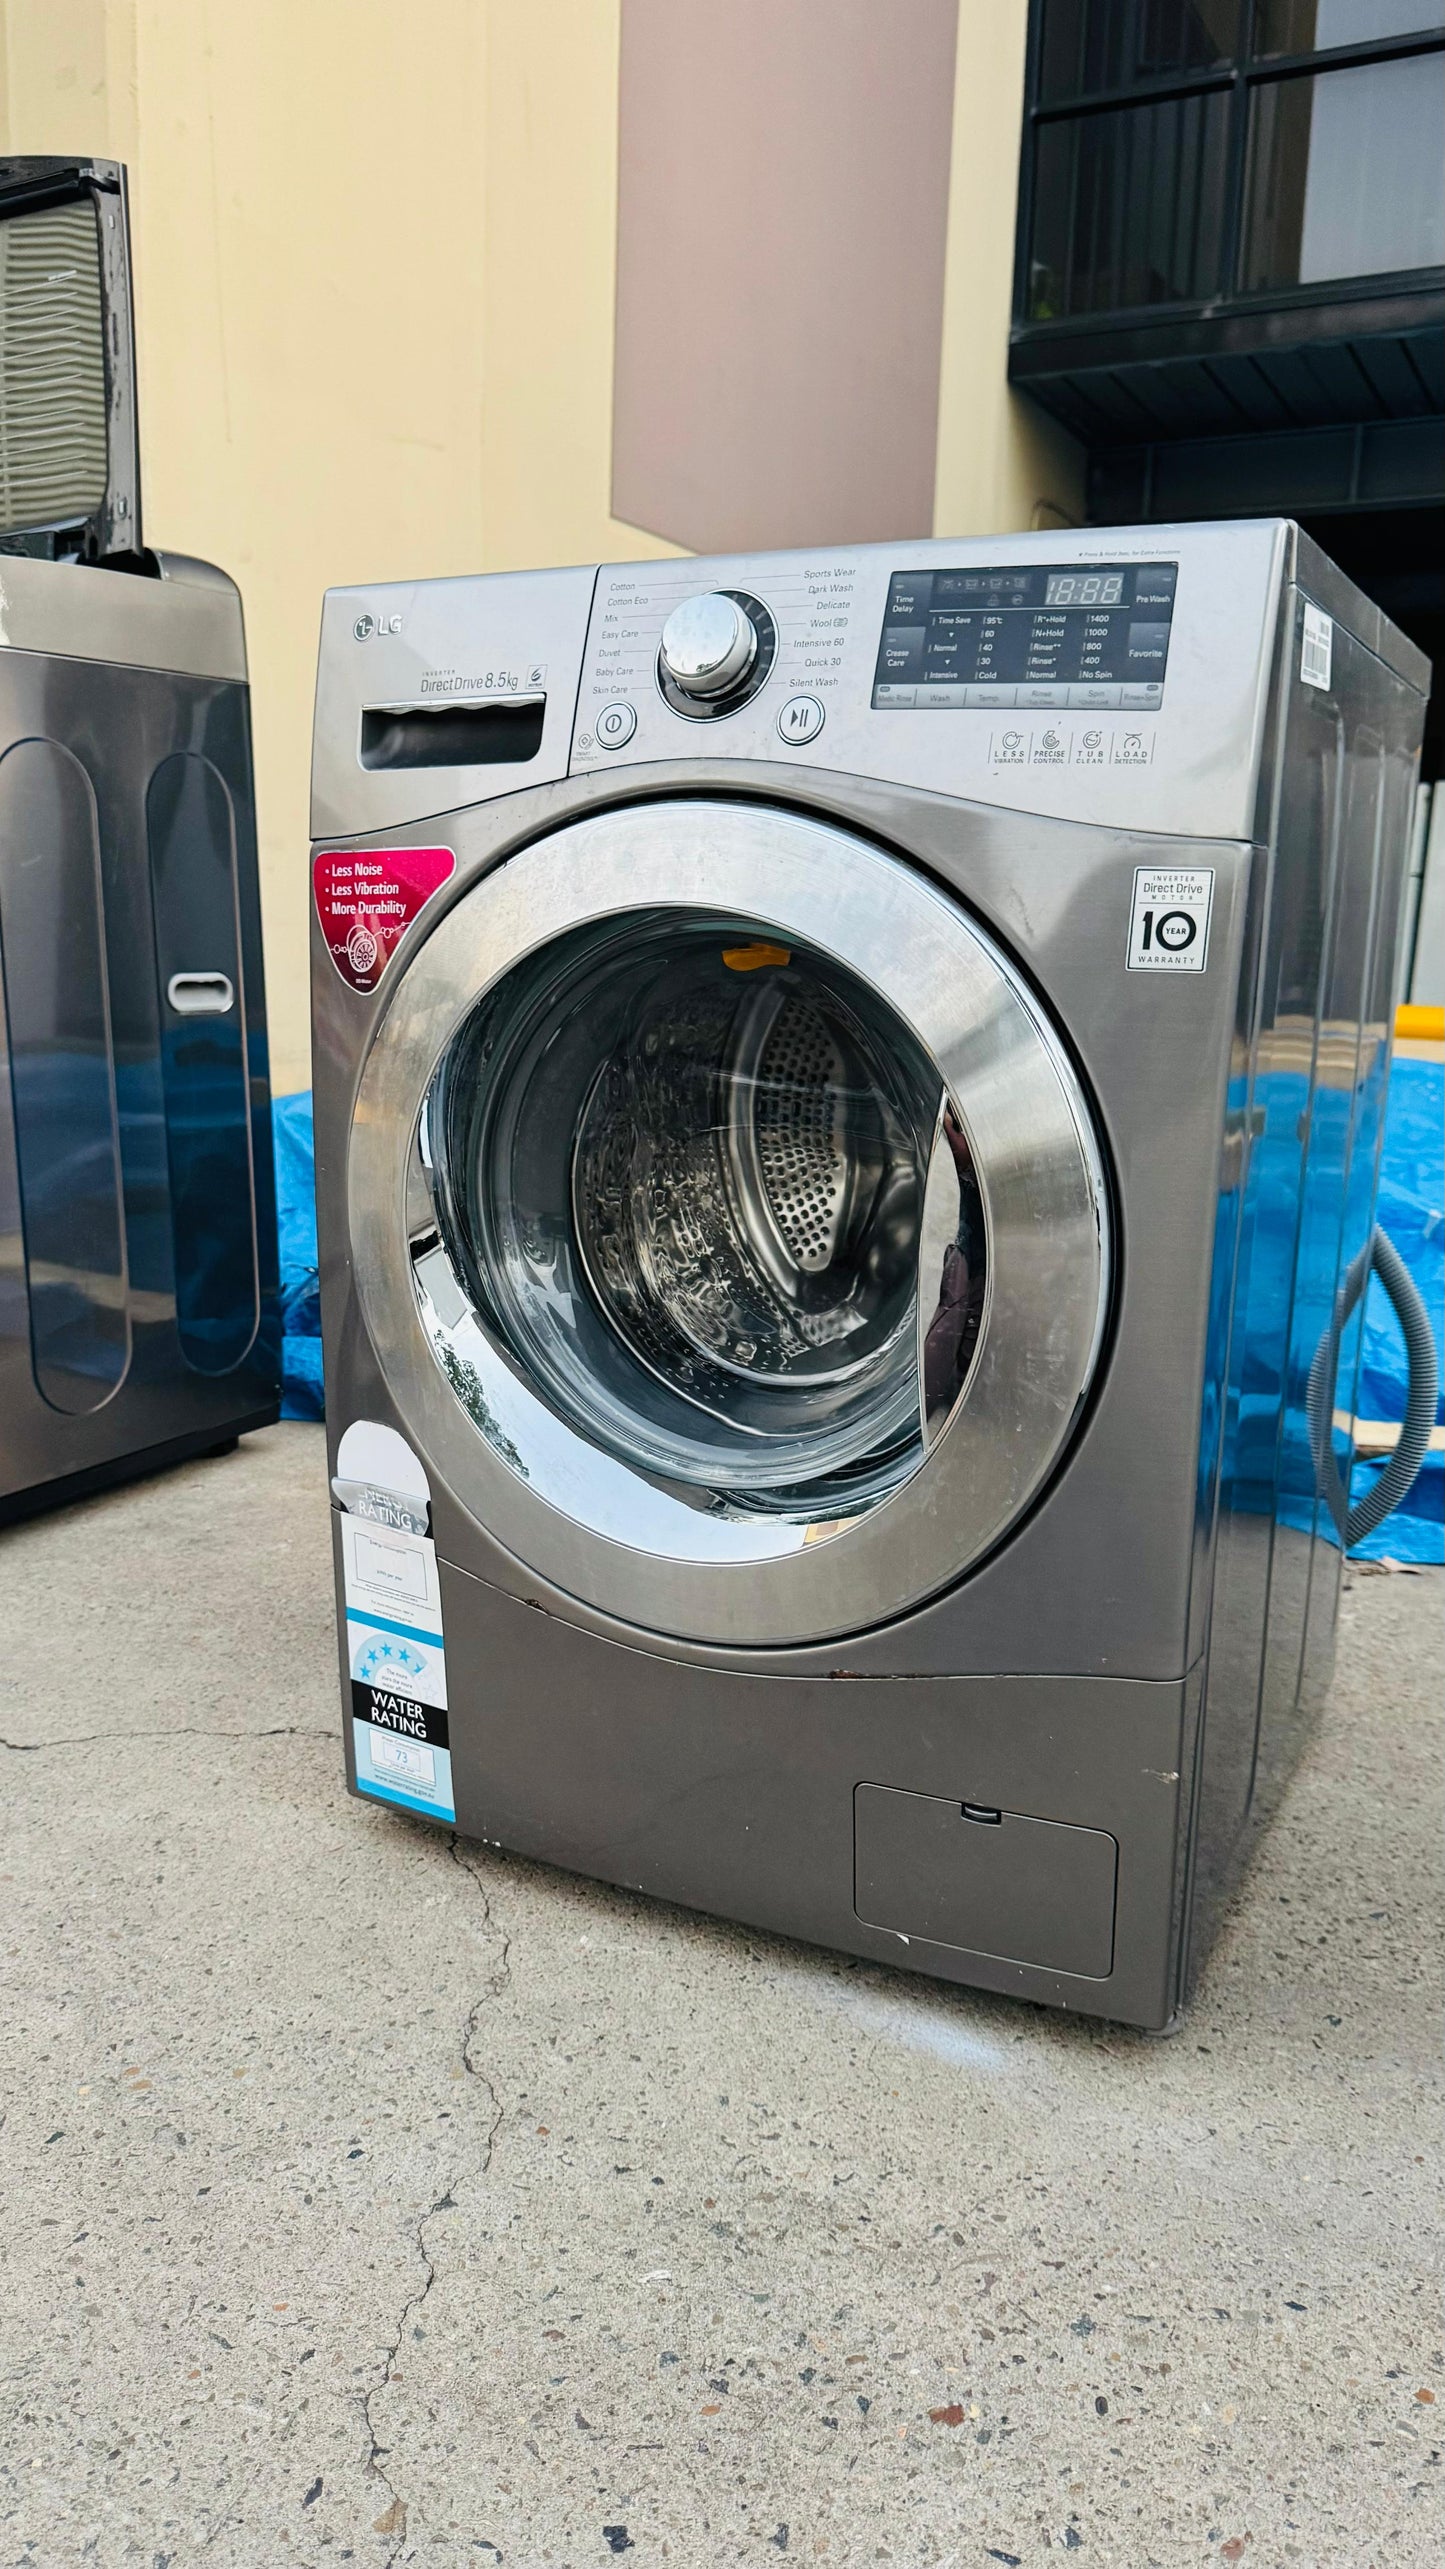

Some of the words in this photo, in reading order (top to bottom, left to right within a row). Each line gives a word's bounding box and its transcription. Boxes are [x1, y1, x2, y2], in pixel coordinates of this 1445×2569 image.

[804, 570, 831, 579] Sports
[833, 568, 856, 577] Wear
[610, 582, 635, 591] Cotton
[808, 585, 827, 593] Dark
[830, 584, 854, 593] Wash
[608, 598, 632, 607] Cotton
[634, 596, 649, 605] Eco
[895, 595, 914, 603] Time
[1136, 595, 1148, 603] Pre
[1149, 595, 1171, 603] Wash
[816, 601, 851, 610] Delicate
[892, 605, 914, 614] Delay
[604, 614, 618, 622] Mix
[938, 616, 954, 624] Time
[955, 616, 971, 624] Save
[1090, 614, 1110, 622] 1400
[377, 614, 402, 636] LG
[809, 619, 832, 628] Wool
[601, 630, 618, 640] Easy
[621, 629, 639, 638] Care
[985, 630, 995, 638] 60
[1088, 628, 1108, 636] 1000
[793, 639, 832, 648] Intensive
[834, 637, 844, 646] 60
[982, 643, 993, 651] 40
[1086, 642, 1101, 651] 800
[933, 644, 957, 652] Normal
[599, 649, 621, 657] Duvet
[886, 649, 909, 657] Crease
[1129, 649, 1163, 658] Favorite
[805, 658, 828, 667] Quick
[830, 657, 841, 666] 30
[887, 659, 905, 667] Care
[980, 657, 991, 665] 30
[1084, 656, 1100, 665] 400
[595, 668, 614, 677] Baby
[616, 667, 634, 676] Care
[978, 671, 997, 679] Cold
[1029, 671, 1057, 679] Normal
[1082, 671, 1093, 679] No
[1094, 670, 1113, 680] Spin
[789, 678, 813, 688] Silent
[815, 677, 839, 687] Wash
[592, 686, 609, 695] Skin
[610, 685, 628, 694] Care
[1088, 689, 1105, 698] Spin
[929, 694, 951, 702] Wash
[994, 750, 1024, 758] LESS
[1034, 750, 1065, 758] PRECISE
[1077, 750, 1104, 758] TUB
[331, 863, 352, 877] Less
[355, 862, 383, 876] Noise
[331, 883, 352, 896] Less
[354, 881, 389, 895] Vibration
[1143, 882, 1174, 893] Direct
[1176, 883, 1203, 894] Drive
[331, 902, 356, 915] More
[358, 900, 407, 918] Durability
[1142, 910, 1197, 951] 10
[1165, 927, 1187, 935] YEAR
[1138, 956, 1195, 964] WARRANTY
[358, 1499, 412, 1530] RATING
[371, 1688, 425, 1721] WATER
[371, 1706, 427, 1738] RATING
[396, 1749, 408, 1764] 73
